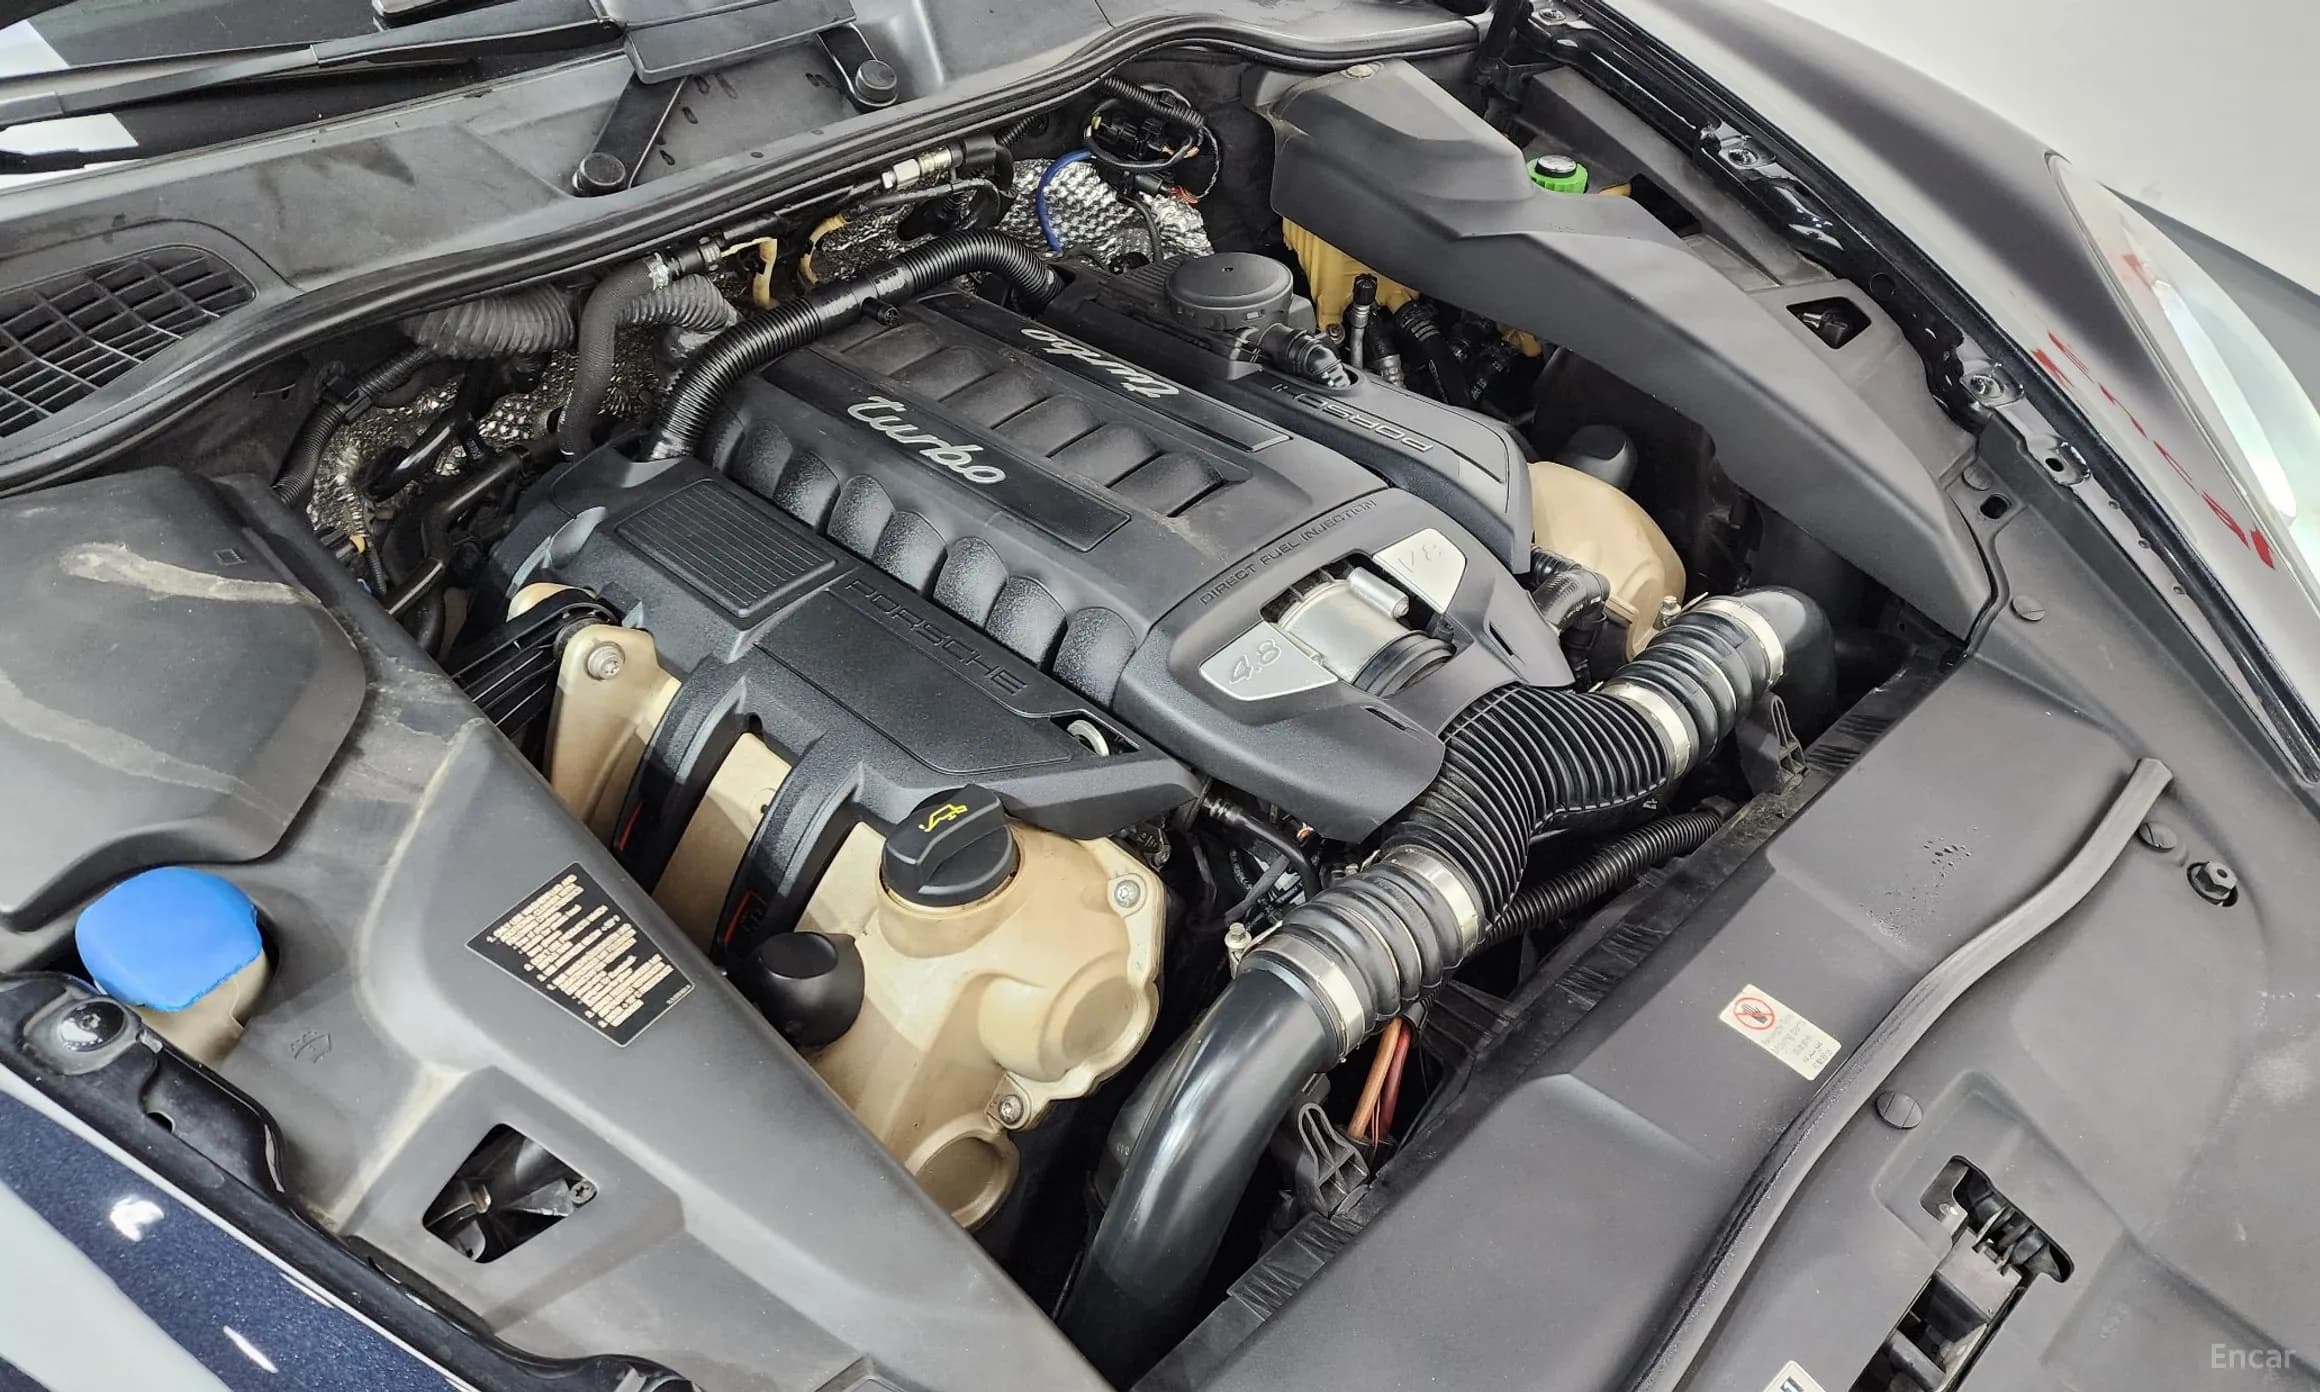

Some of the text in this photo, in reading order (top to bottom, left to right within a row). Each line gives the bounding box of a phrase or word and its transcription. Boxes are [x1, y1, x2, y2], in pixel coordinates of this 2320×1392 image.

[1200, 499, 1377, 605] DIRECT FUEL INJECTION
[845, 578, 1028, 697] PORSCHE
[1229, 638, 1283, 686] 4.8
